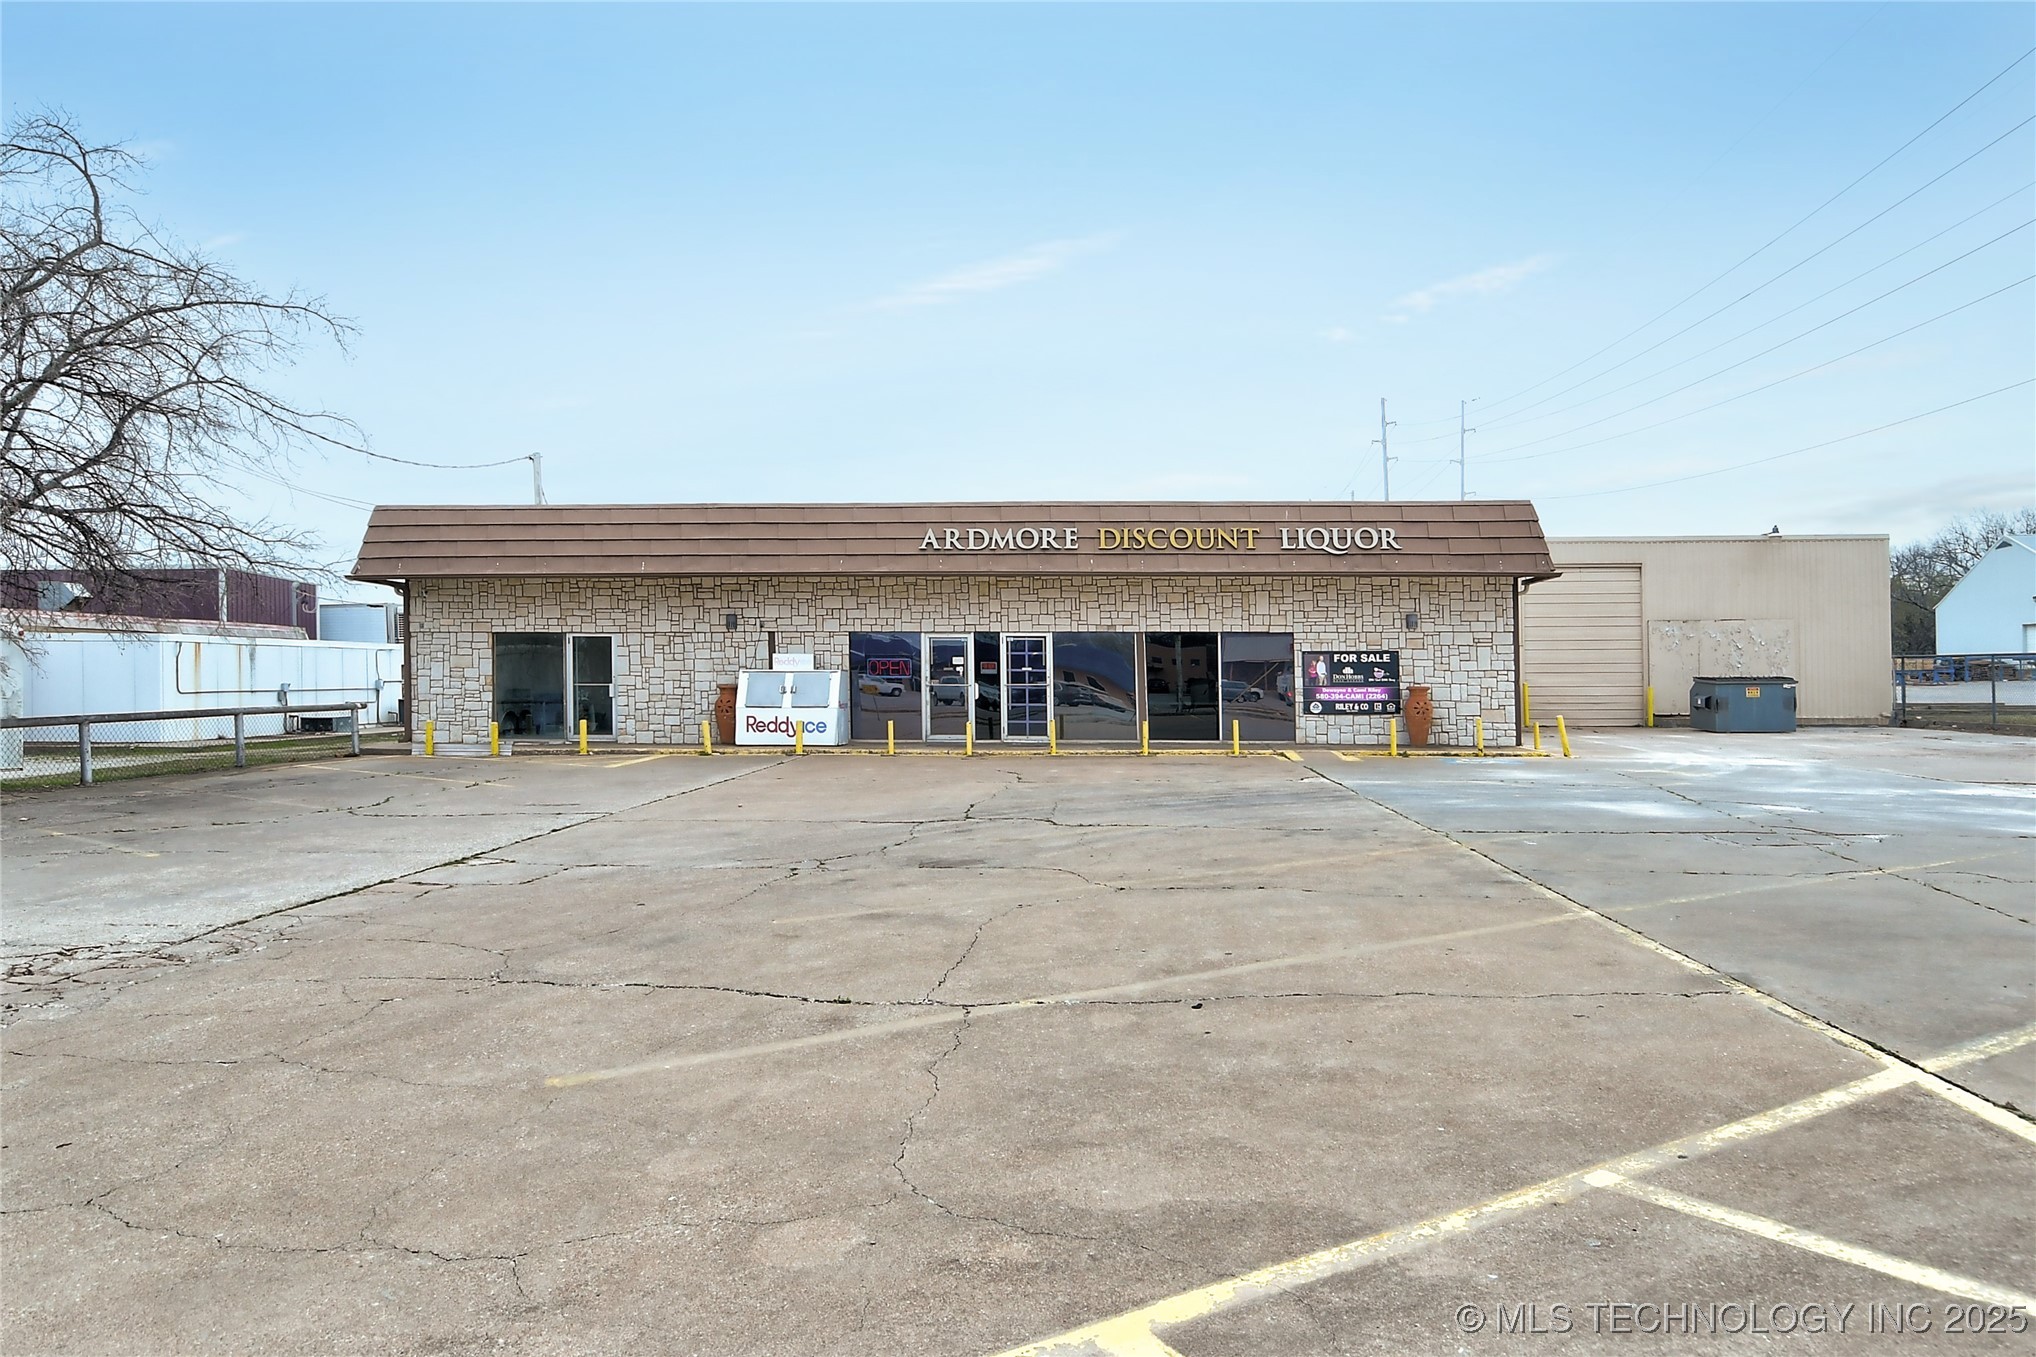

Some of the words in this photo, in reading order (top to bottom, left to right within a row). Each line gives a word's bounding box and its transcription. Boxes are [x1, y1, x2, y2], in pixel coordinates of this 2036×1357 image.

[918, 527, 1079, 551] ARDMORE
[1098, 527, 1261, 551] DISCOUNT
[1278, 527, 1403, 555] LIQUOR
[1333, 653, 1358, 663] FOR
[1360, 653, 1391, 663] SALE
[868, 659, 911, 676] OPEN
[1335, 703, 1354, 711] RILEY
[1360, 703, 1369, 711] CO
